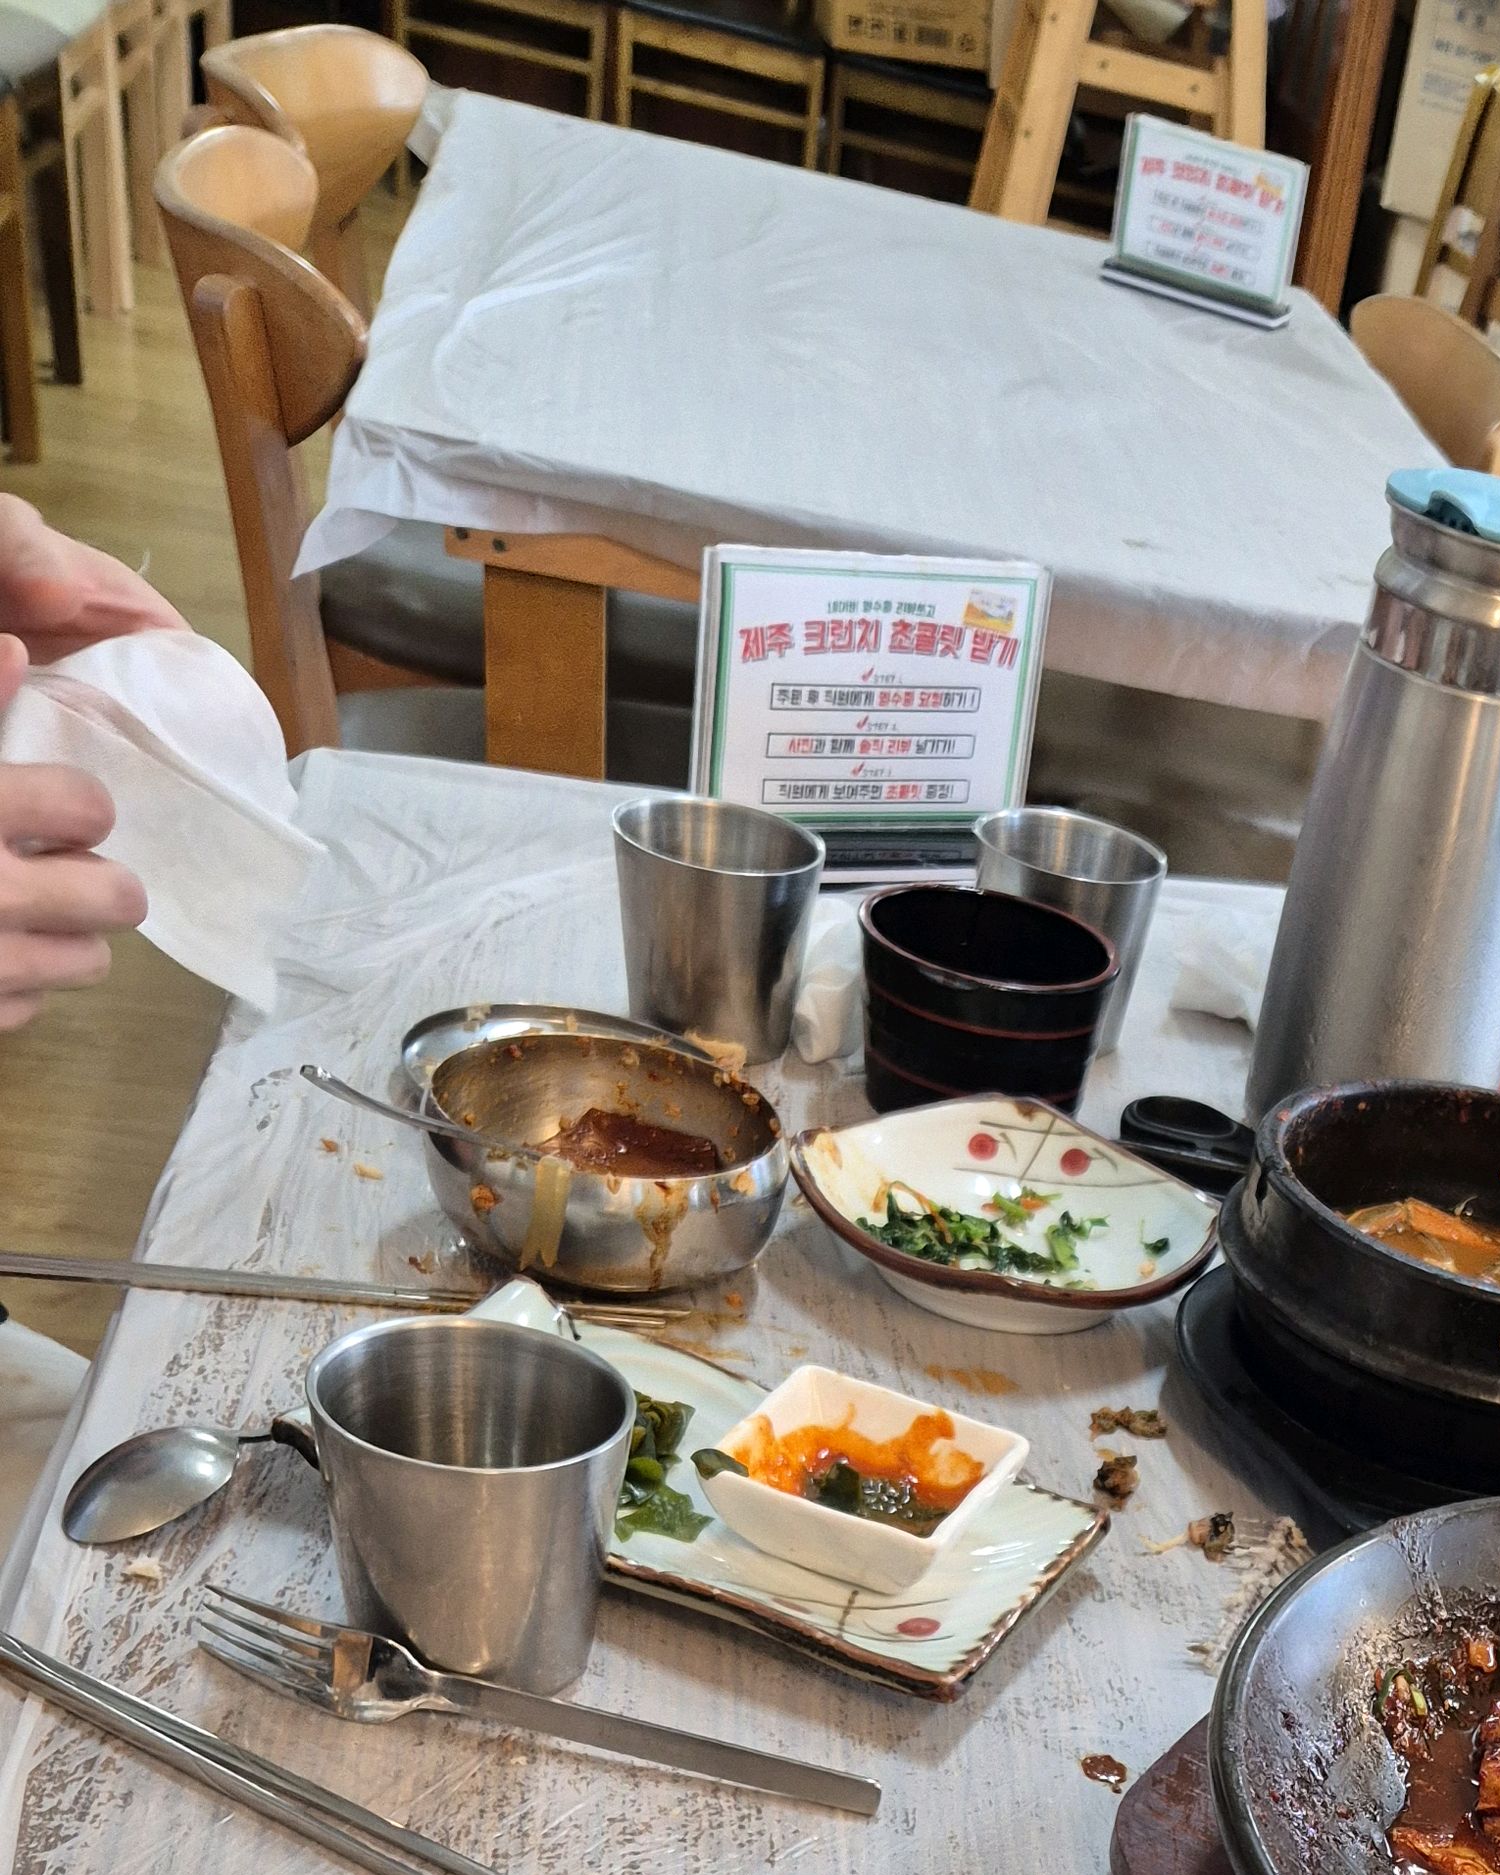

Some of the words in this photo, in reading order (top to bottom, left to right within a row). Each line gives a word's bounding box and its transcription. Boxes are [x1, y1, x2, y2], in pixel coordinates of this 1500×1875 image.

[739, 623, 794, 664] 제주
[803, 618, 880, 656] 크런치
[969, 628, 1020, 671] 받기
